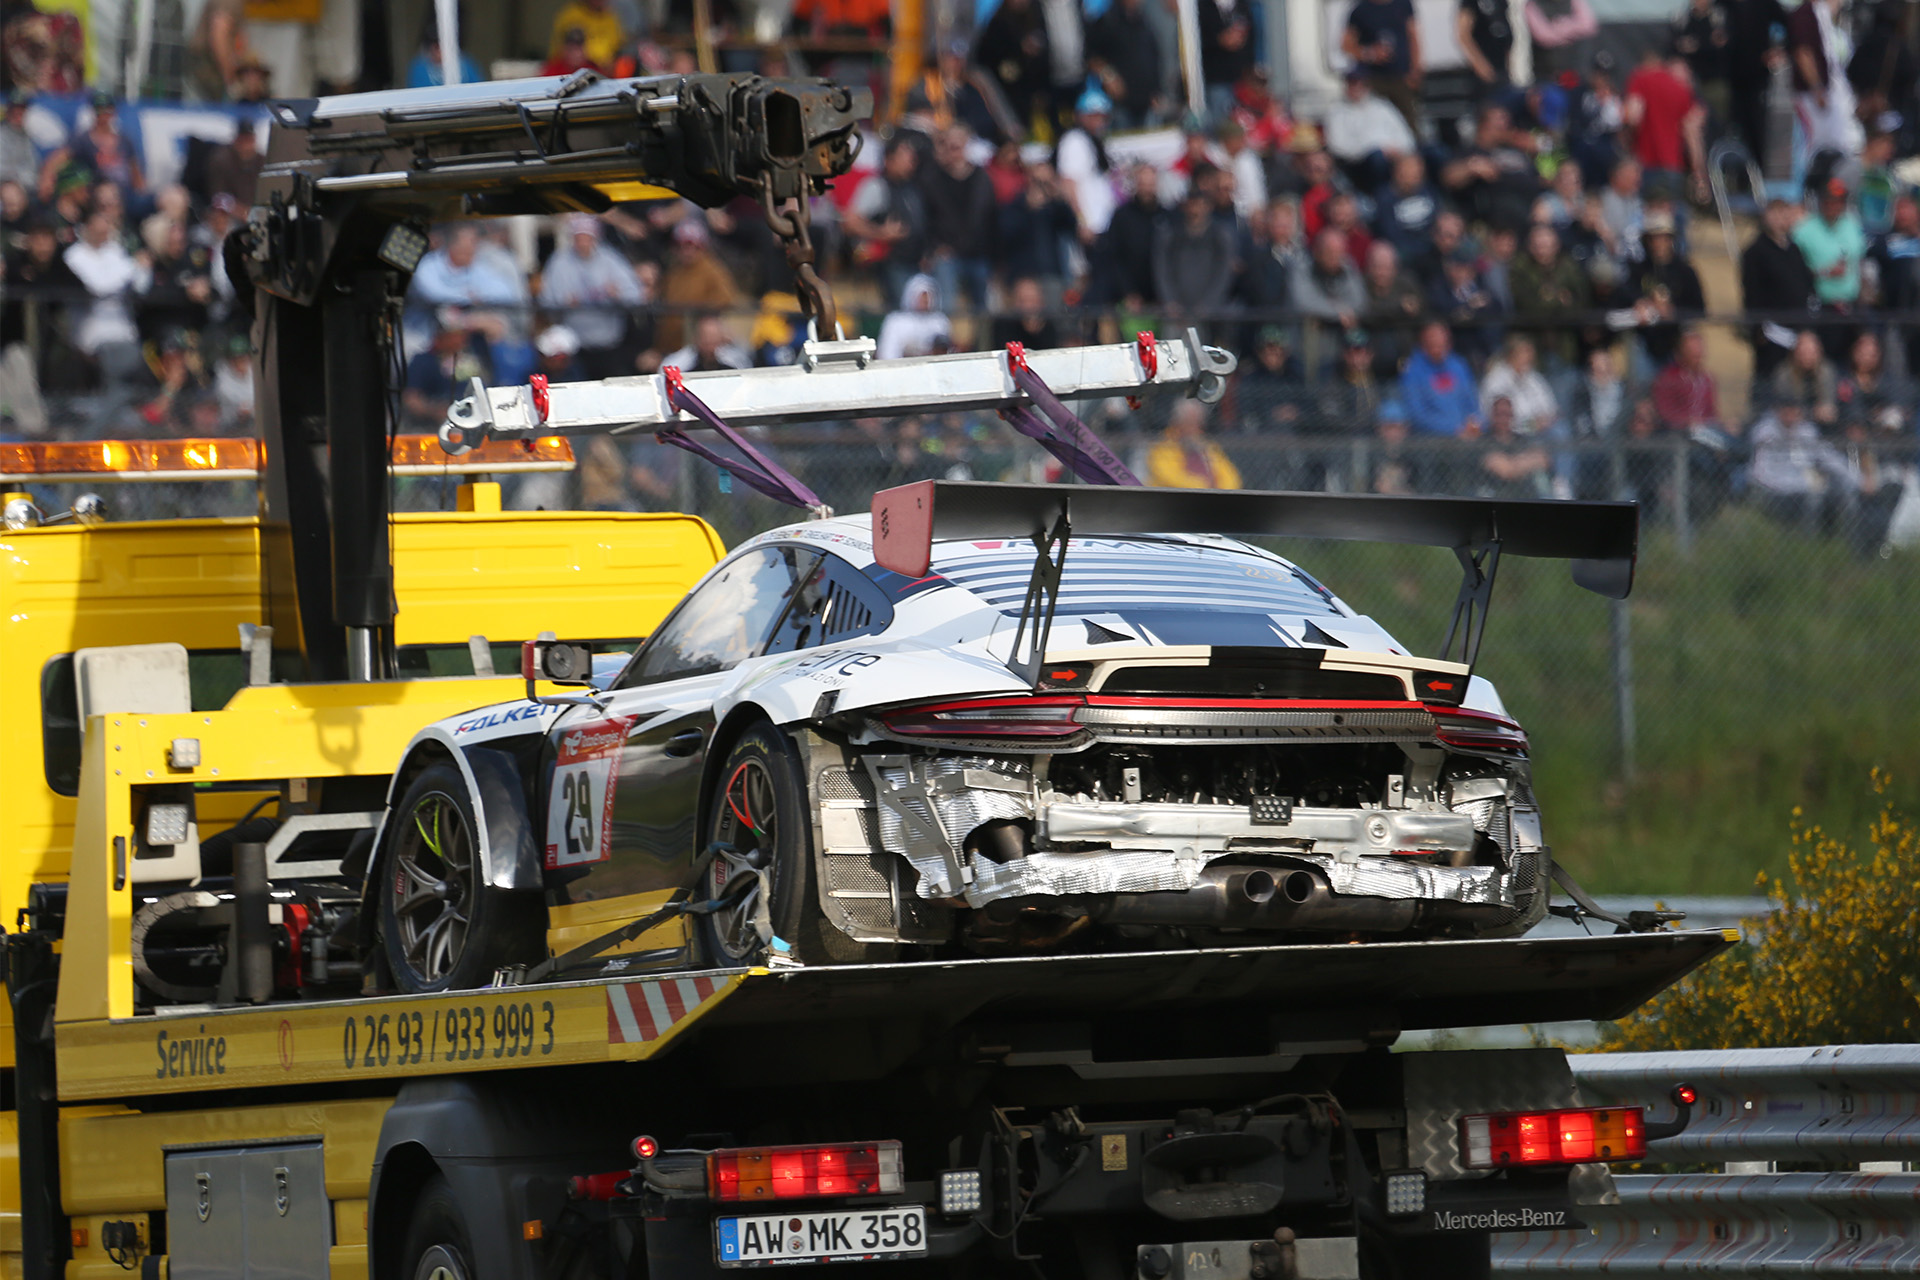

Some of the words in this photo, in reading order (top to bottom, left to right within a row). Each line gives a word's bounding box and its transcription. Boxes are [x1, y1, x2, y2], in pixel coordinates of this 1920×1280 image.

[563, 770, 593, 855] 29
[156, 1024, 226, 1079] Service
[344, 1016, 356, 1069] 0
[364, 1014, 390, 1067] 26
[397, 1012, 423, 1065] 93
[445, 1006, 485, 1062] 933
[493, 1002, 534, 1058] 999
[541, 1000, 554, 1055] 3
[742, 1220, 784, 1255] AW
[808, 1217, 852, 1252] MK
[860, 1213, 922, 1249] 358
[1433, 1208, 1566, 1230] Mercedes-Benz
[725, 1243, 734, 1253] D
